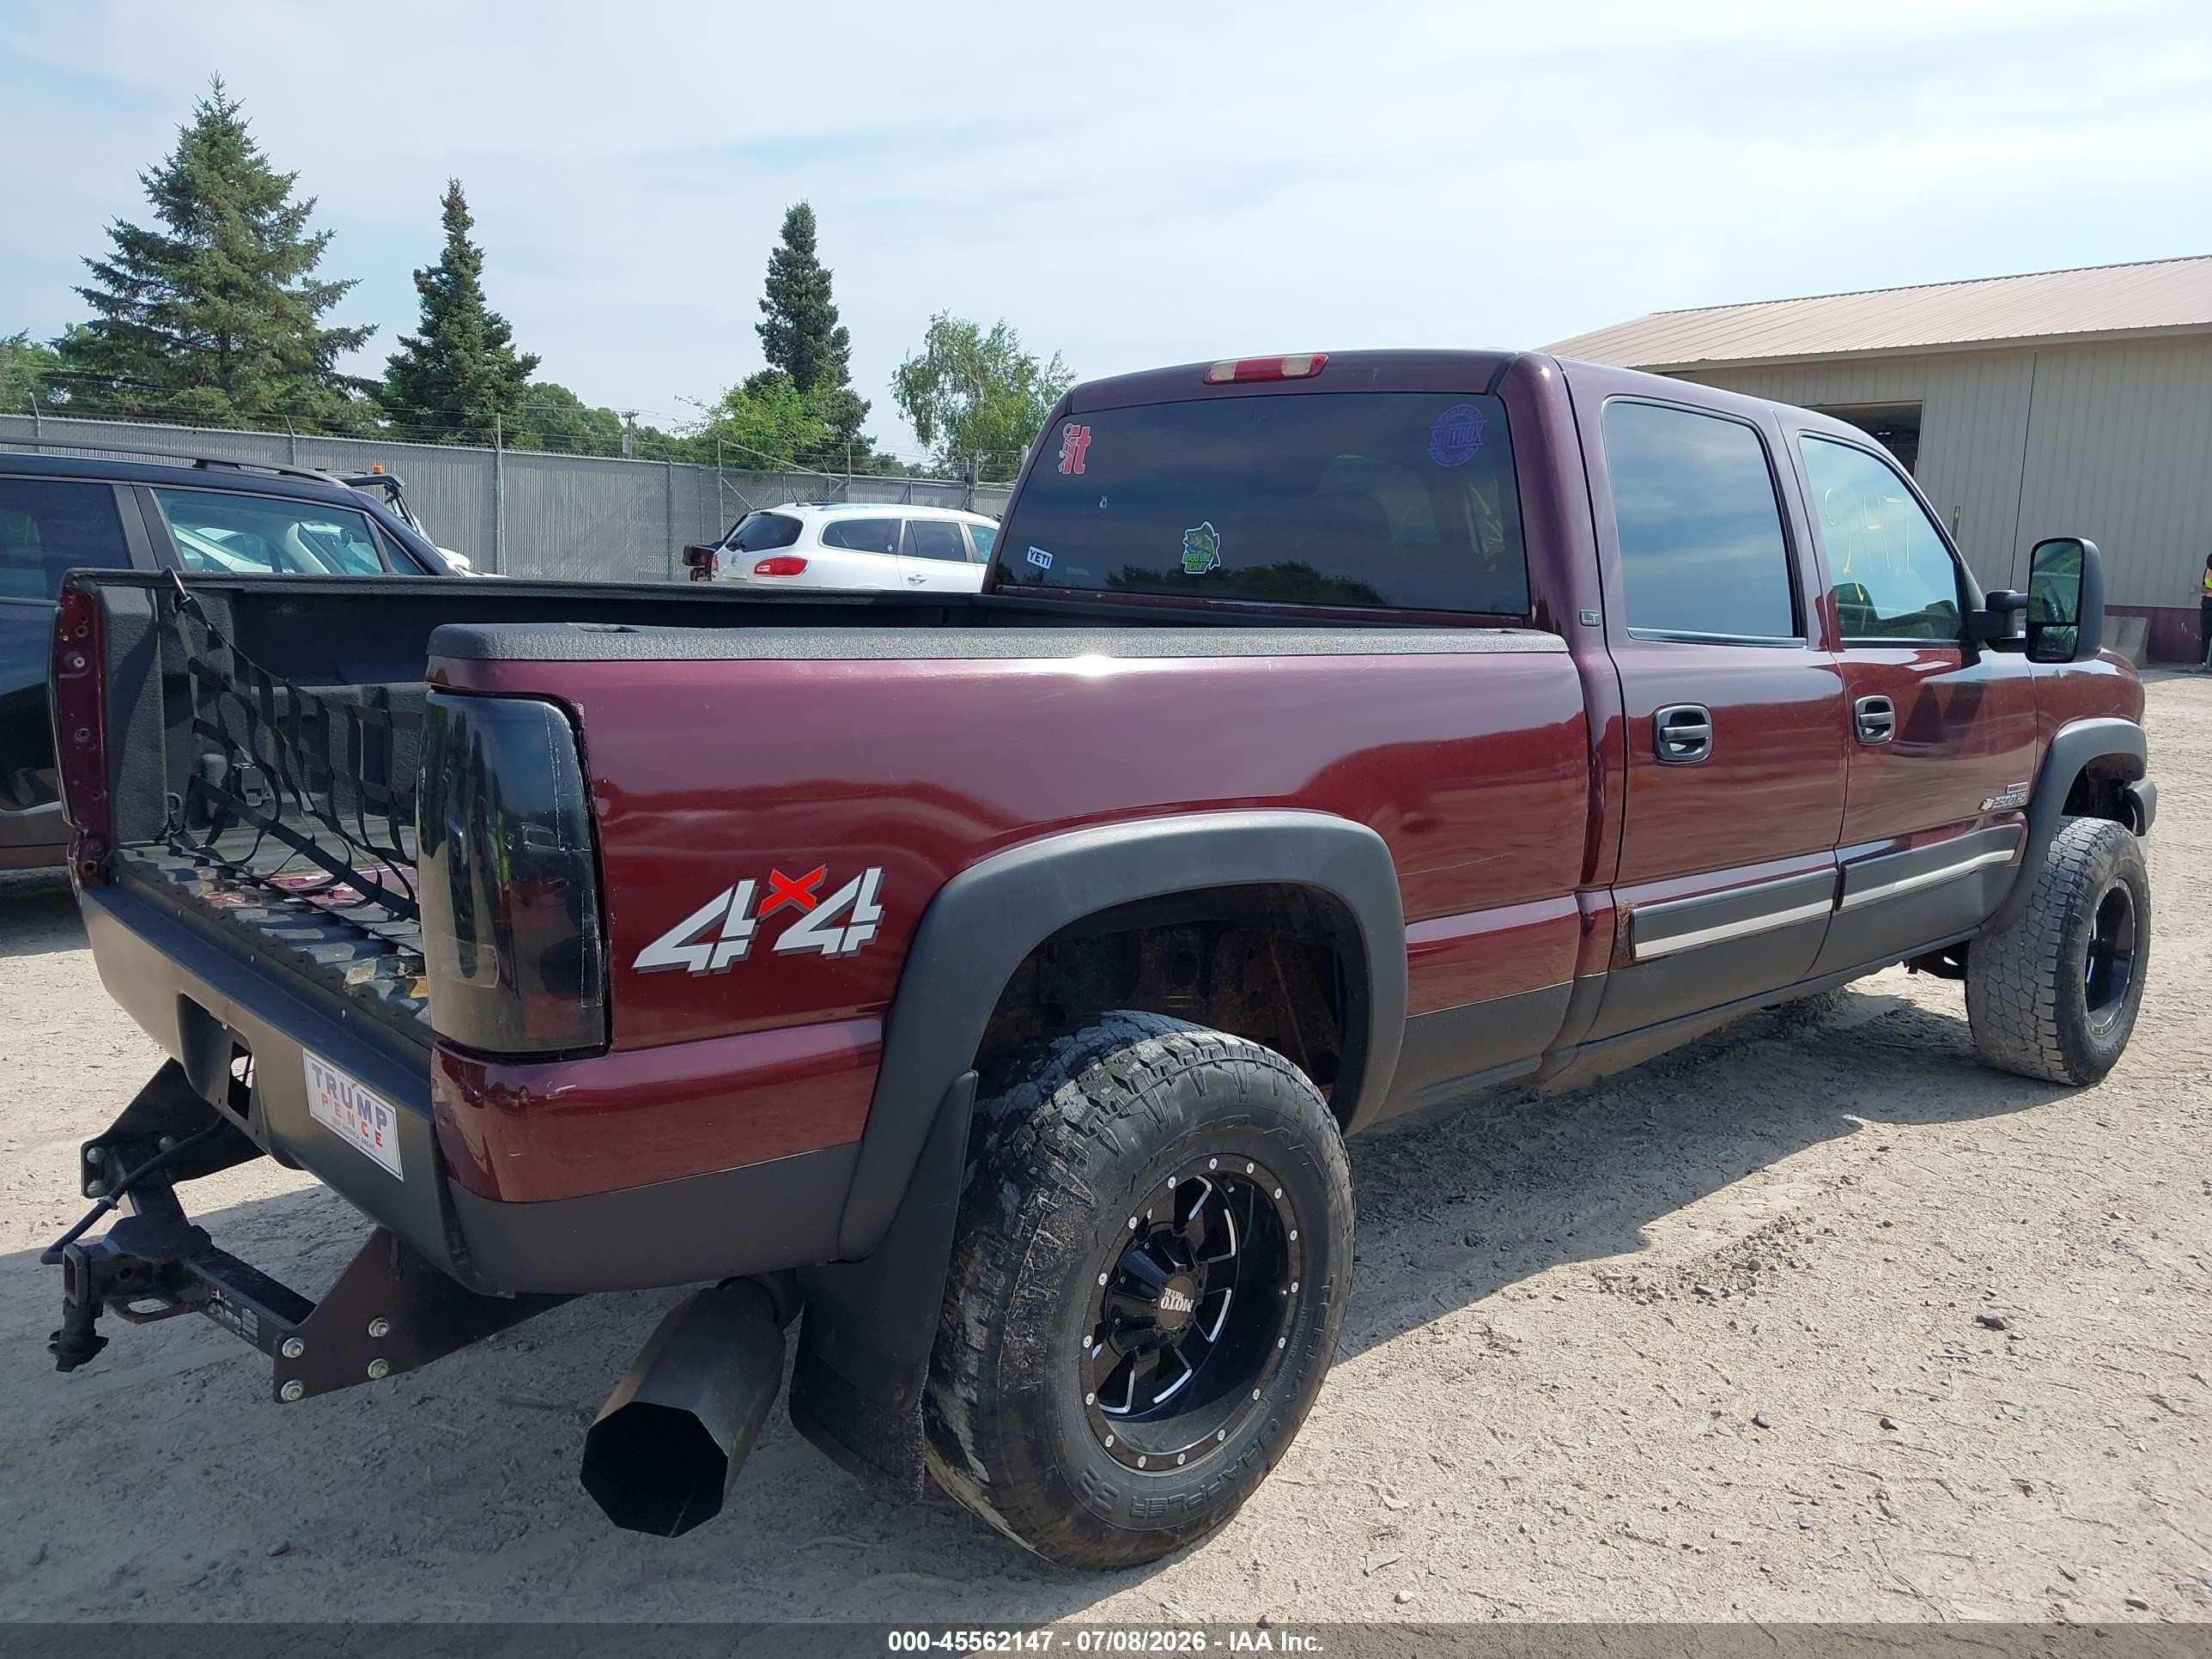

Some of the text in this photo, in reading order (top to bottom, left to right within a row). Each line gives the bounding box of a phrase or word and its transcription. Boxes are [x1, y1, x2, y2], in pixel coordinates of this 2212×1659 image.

[1030, 548, 1050, 567] YETI
[1186, 562, 1207, 571] RESORT
[1581, 611, 1600, 624] LT
[311, 1062, 388, 1131] TRUMP
[320, 1092, 384, 1148] PENCE
[1160, 1296, 1194, 1312] MOTO
